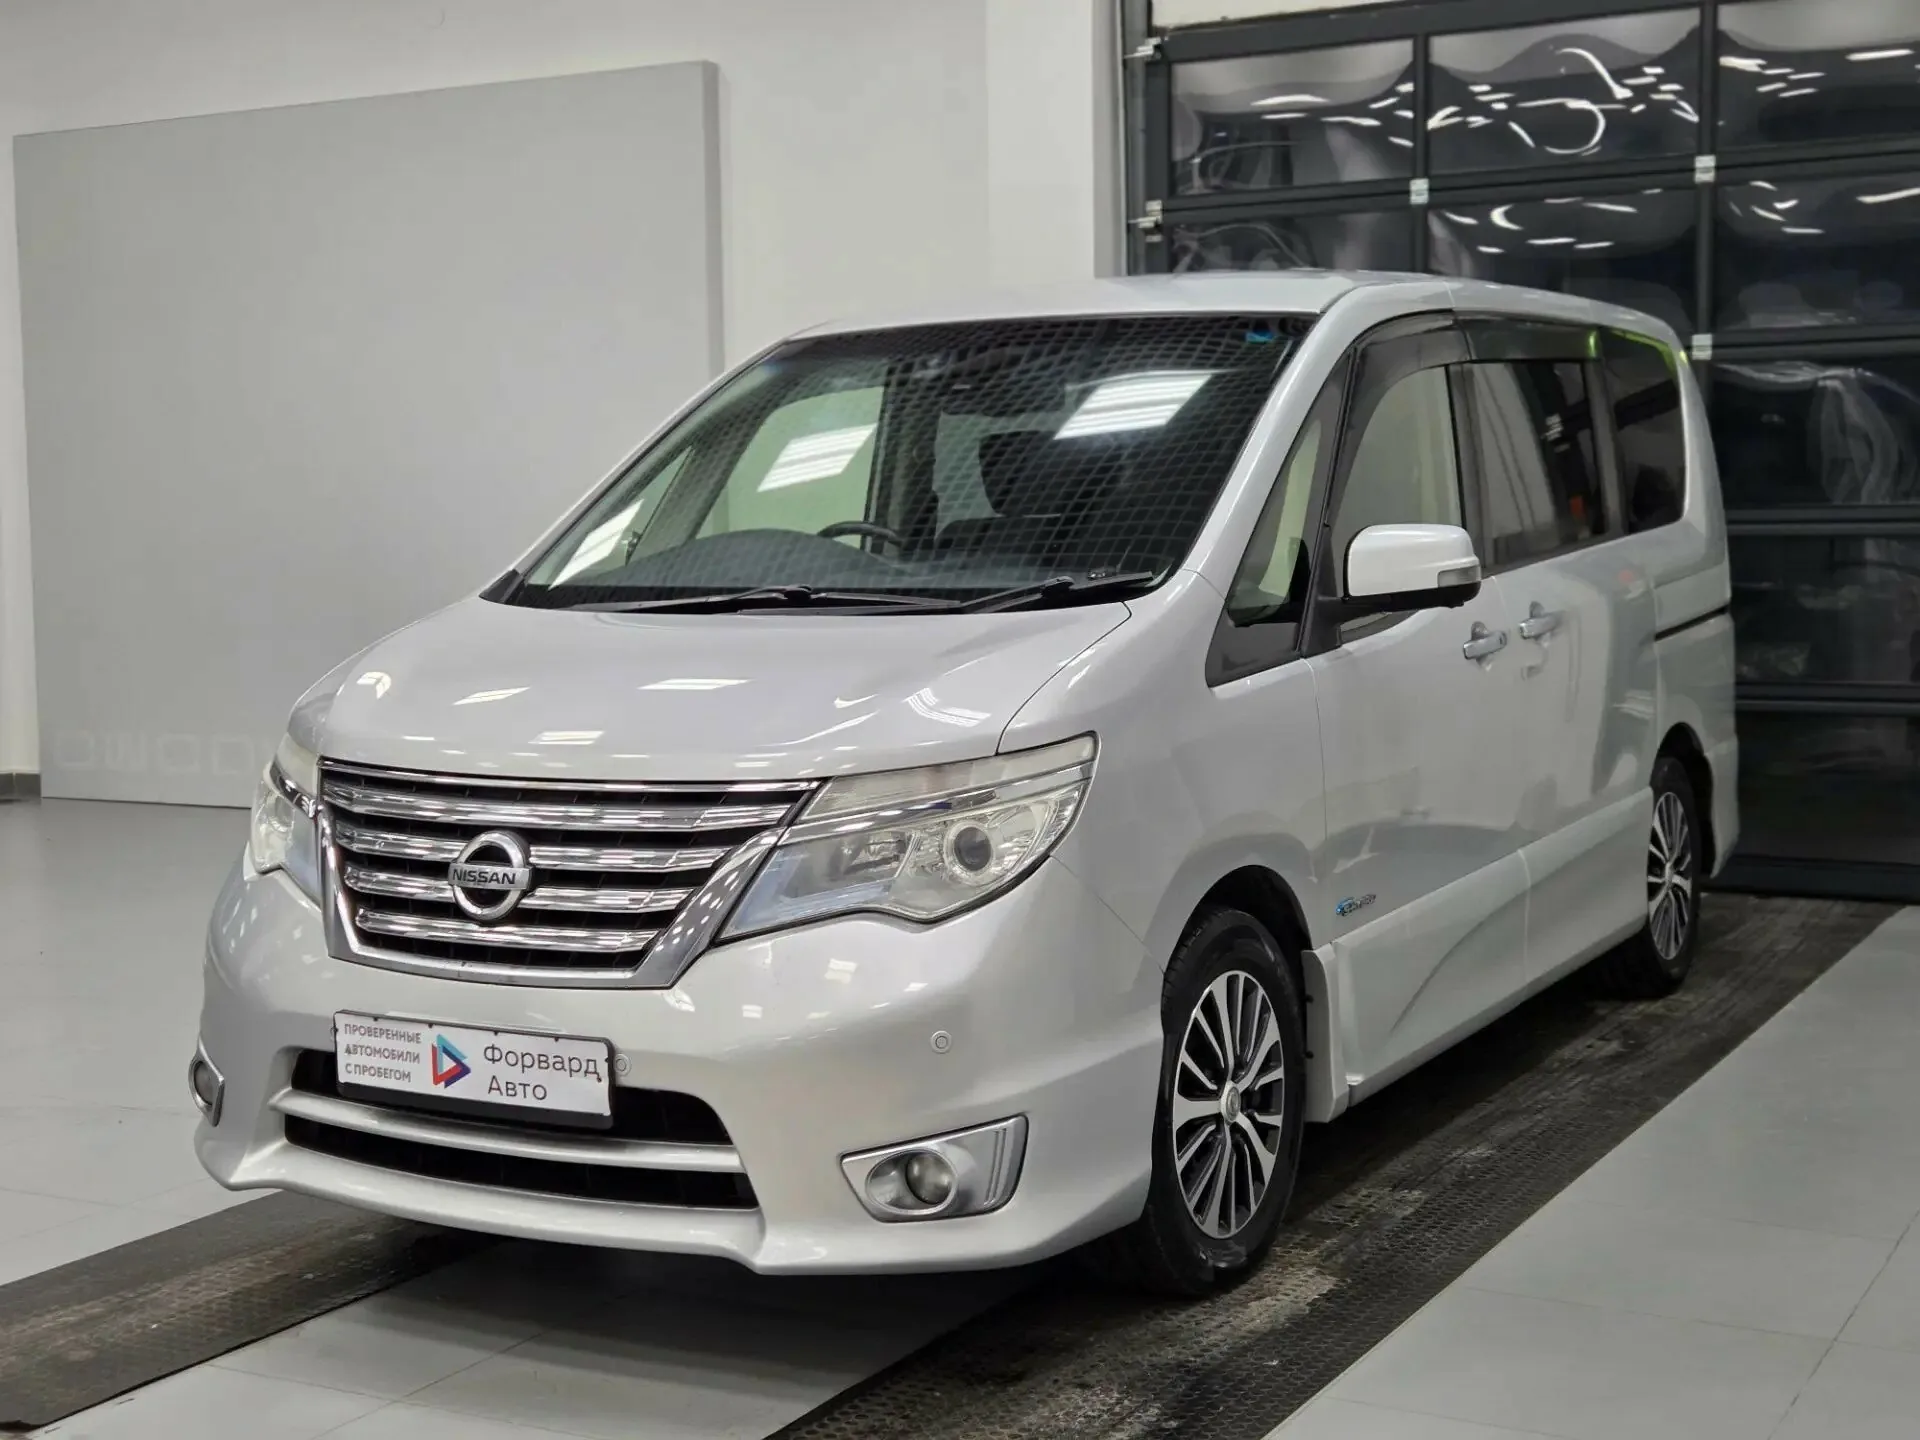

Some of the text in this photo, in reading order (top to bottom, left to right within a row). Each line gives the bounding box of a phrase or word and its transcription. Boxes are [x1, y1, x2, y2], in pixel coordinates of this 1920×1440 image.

[452, 868, 516, 885] NISSAN
[344, 1023, 422, 1044] ПРОВЕРЕННЫЕ
[344, 1043, 420, 1064] АВТОМОБИЛИ
[483, 1043, 601, 1082] Форвард
[345, 1063, 412, 1083] С ПРОБЕГОМ
[487, 1074, 548, 1101] Авто
